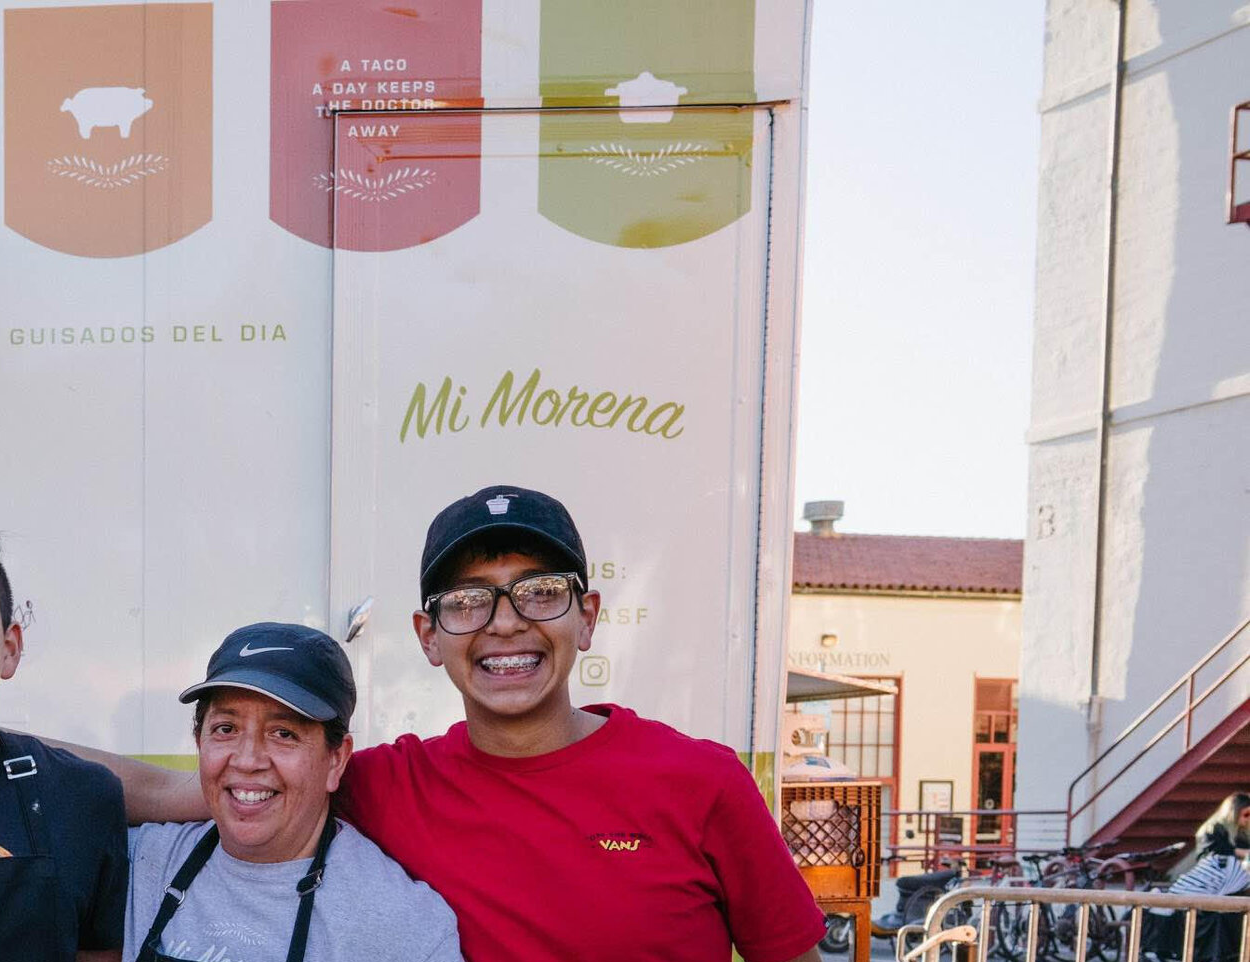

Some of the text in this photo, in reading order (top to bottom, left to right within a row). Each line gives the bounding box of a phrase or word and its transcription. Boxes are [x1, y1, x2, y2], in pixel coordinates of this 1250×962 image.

[340, 58, 408, 72] A TACO
[312, 80, 436, 96] A DAY KEEPS
[361, 98, 435, 111] DOCTOR
[348, 124, 400, 138] AWAY
[9, 324, 287, 346] GUISADOS DEL DIA
[400, 368, 685, 444] Mi Morena
[599, 839, 641, 851] VANS
